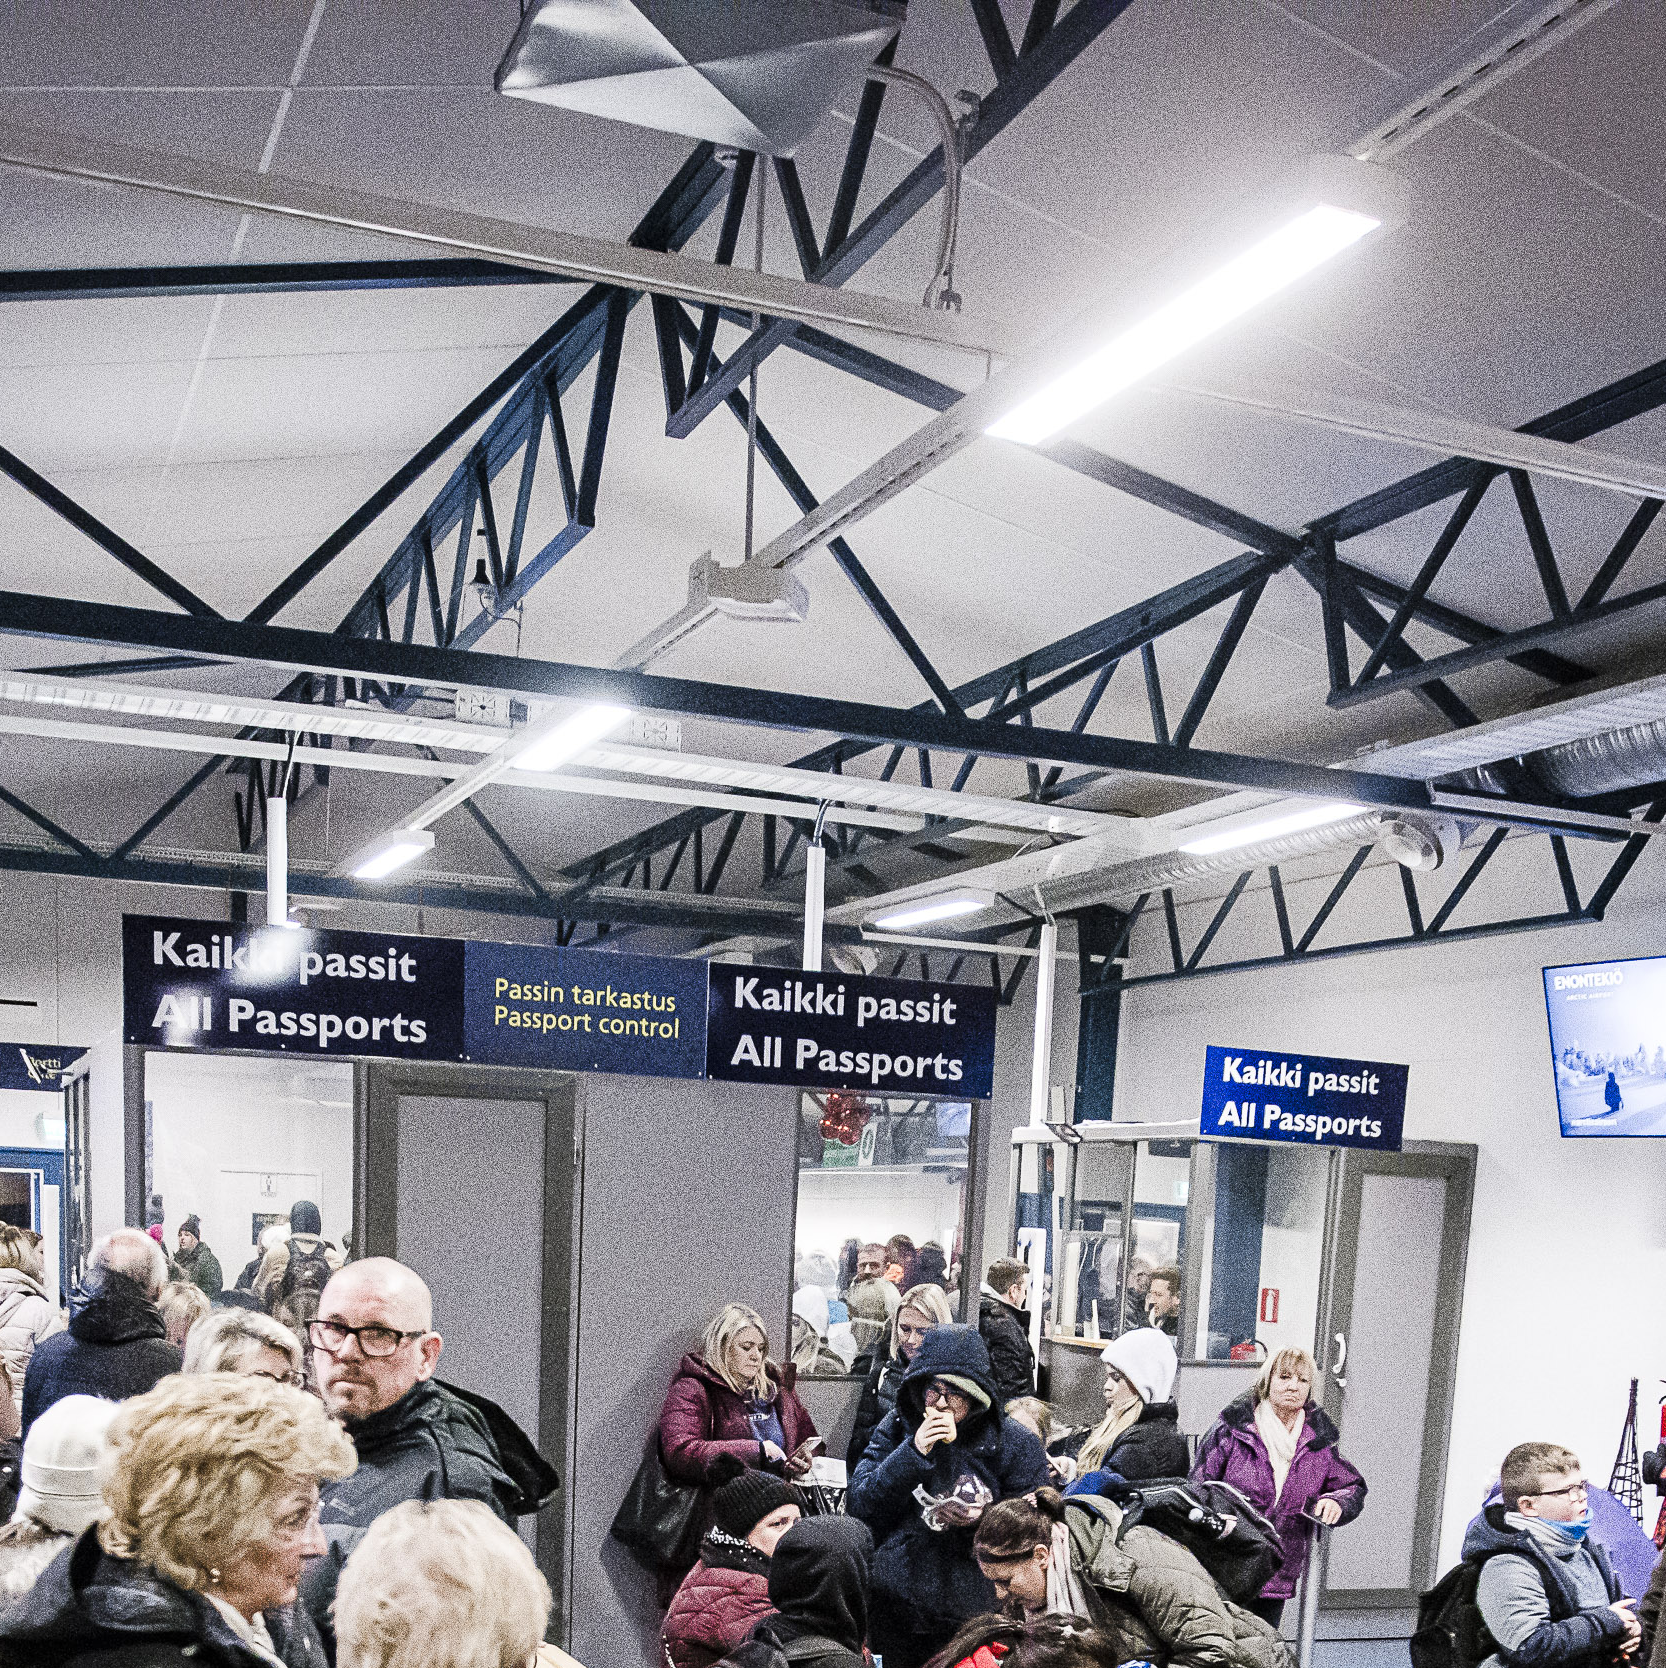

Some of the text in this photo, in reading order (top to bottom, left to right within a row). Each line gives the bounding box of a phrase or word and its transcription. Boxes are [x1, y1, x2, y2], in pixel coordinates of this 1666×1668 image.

[152, 930, 417, 986] Kaikk passit
[1554, 967, 1624, 990] ENONTEKIÖ
[495, 977, 676, 1013] Passin tarkastus
[734, 976, 957, 1028] Kaikki passit
[151, 994, 427, 1048] All Passports
[494, 1005, 680, 1039] Passport control
[730, 1034, 964, 1085] All Passports
[1222, 1056, 1380, 1097] Kaikki passit
[1217, 1101, 1382, 1141] All Passports
